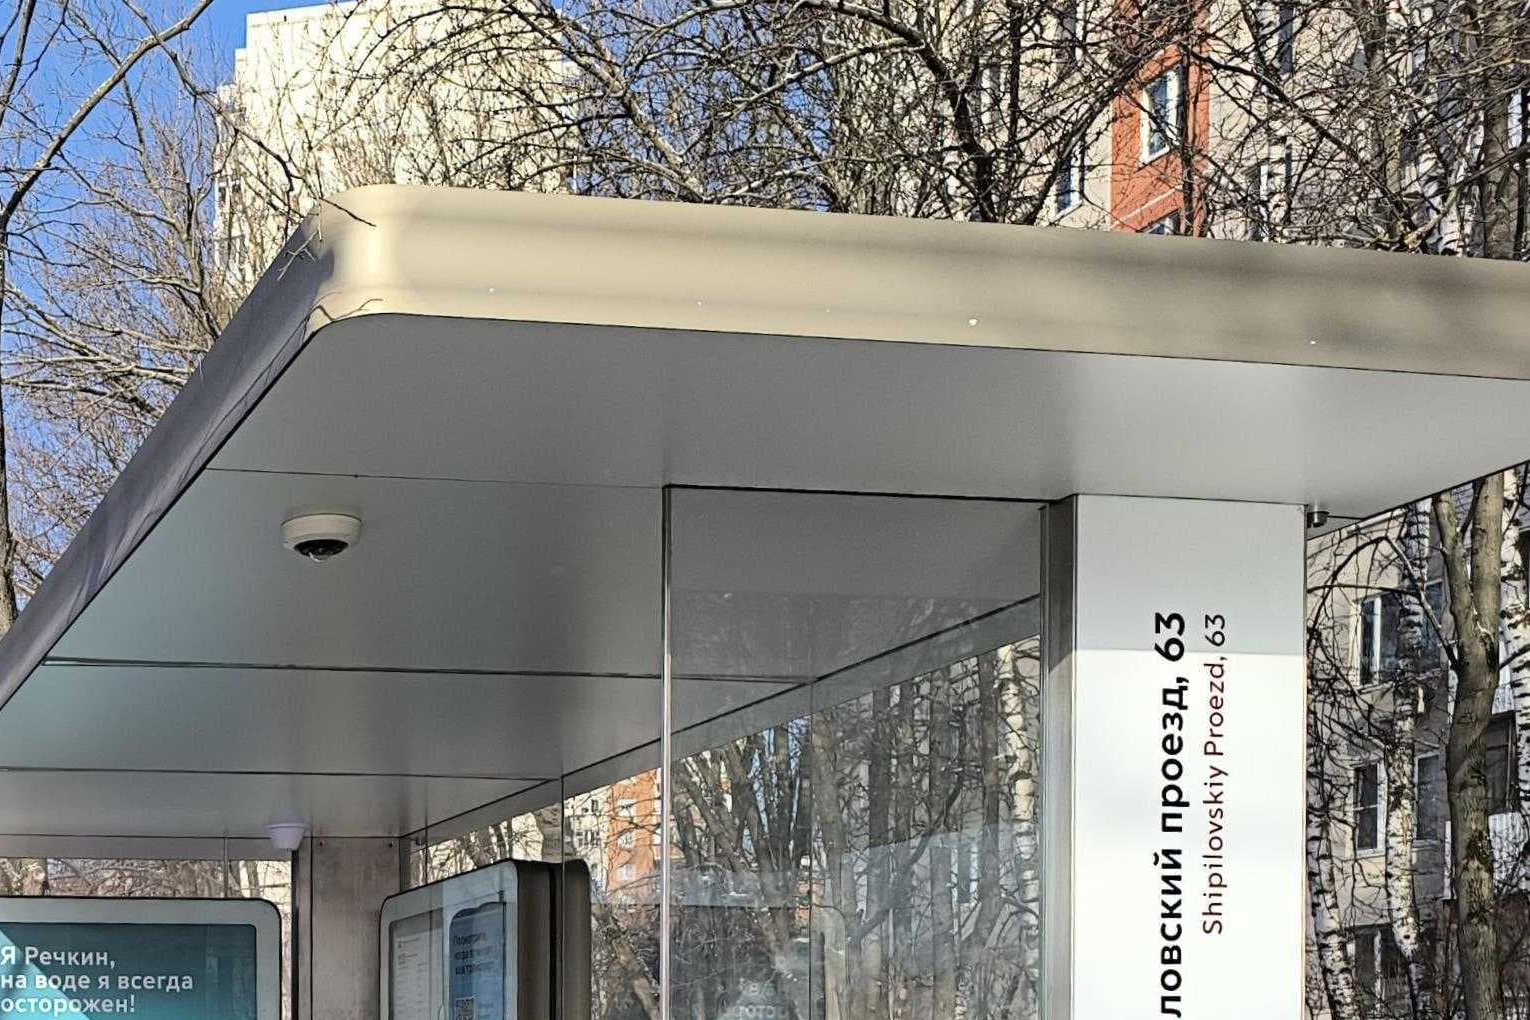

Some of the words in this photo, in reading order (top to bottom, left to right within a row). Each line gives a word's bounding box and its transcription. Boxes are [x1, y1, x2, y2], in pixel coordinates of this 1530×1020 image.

[1154, 612, 1185, 662] 63
[1205, 614, 1225, 647] 63
[1203, 656, 1227, 756] Proezd,
[1161, 676, 1190, 833] проезд,
[1202, 765, 1228, 935] Shipilovskiy
[0, 945, 16, 966] Я
[24, 946, 116, 970] Речкин,
[0, 974, 27, 990] на
[35, 974, 91, 993] воде
[97, 974, 110, 990] я
[117, 974, 194, 993] всегда
[0, 994, 136, 1017] осторожен!
